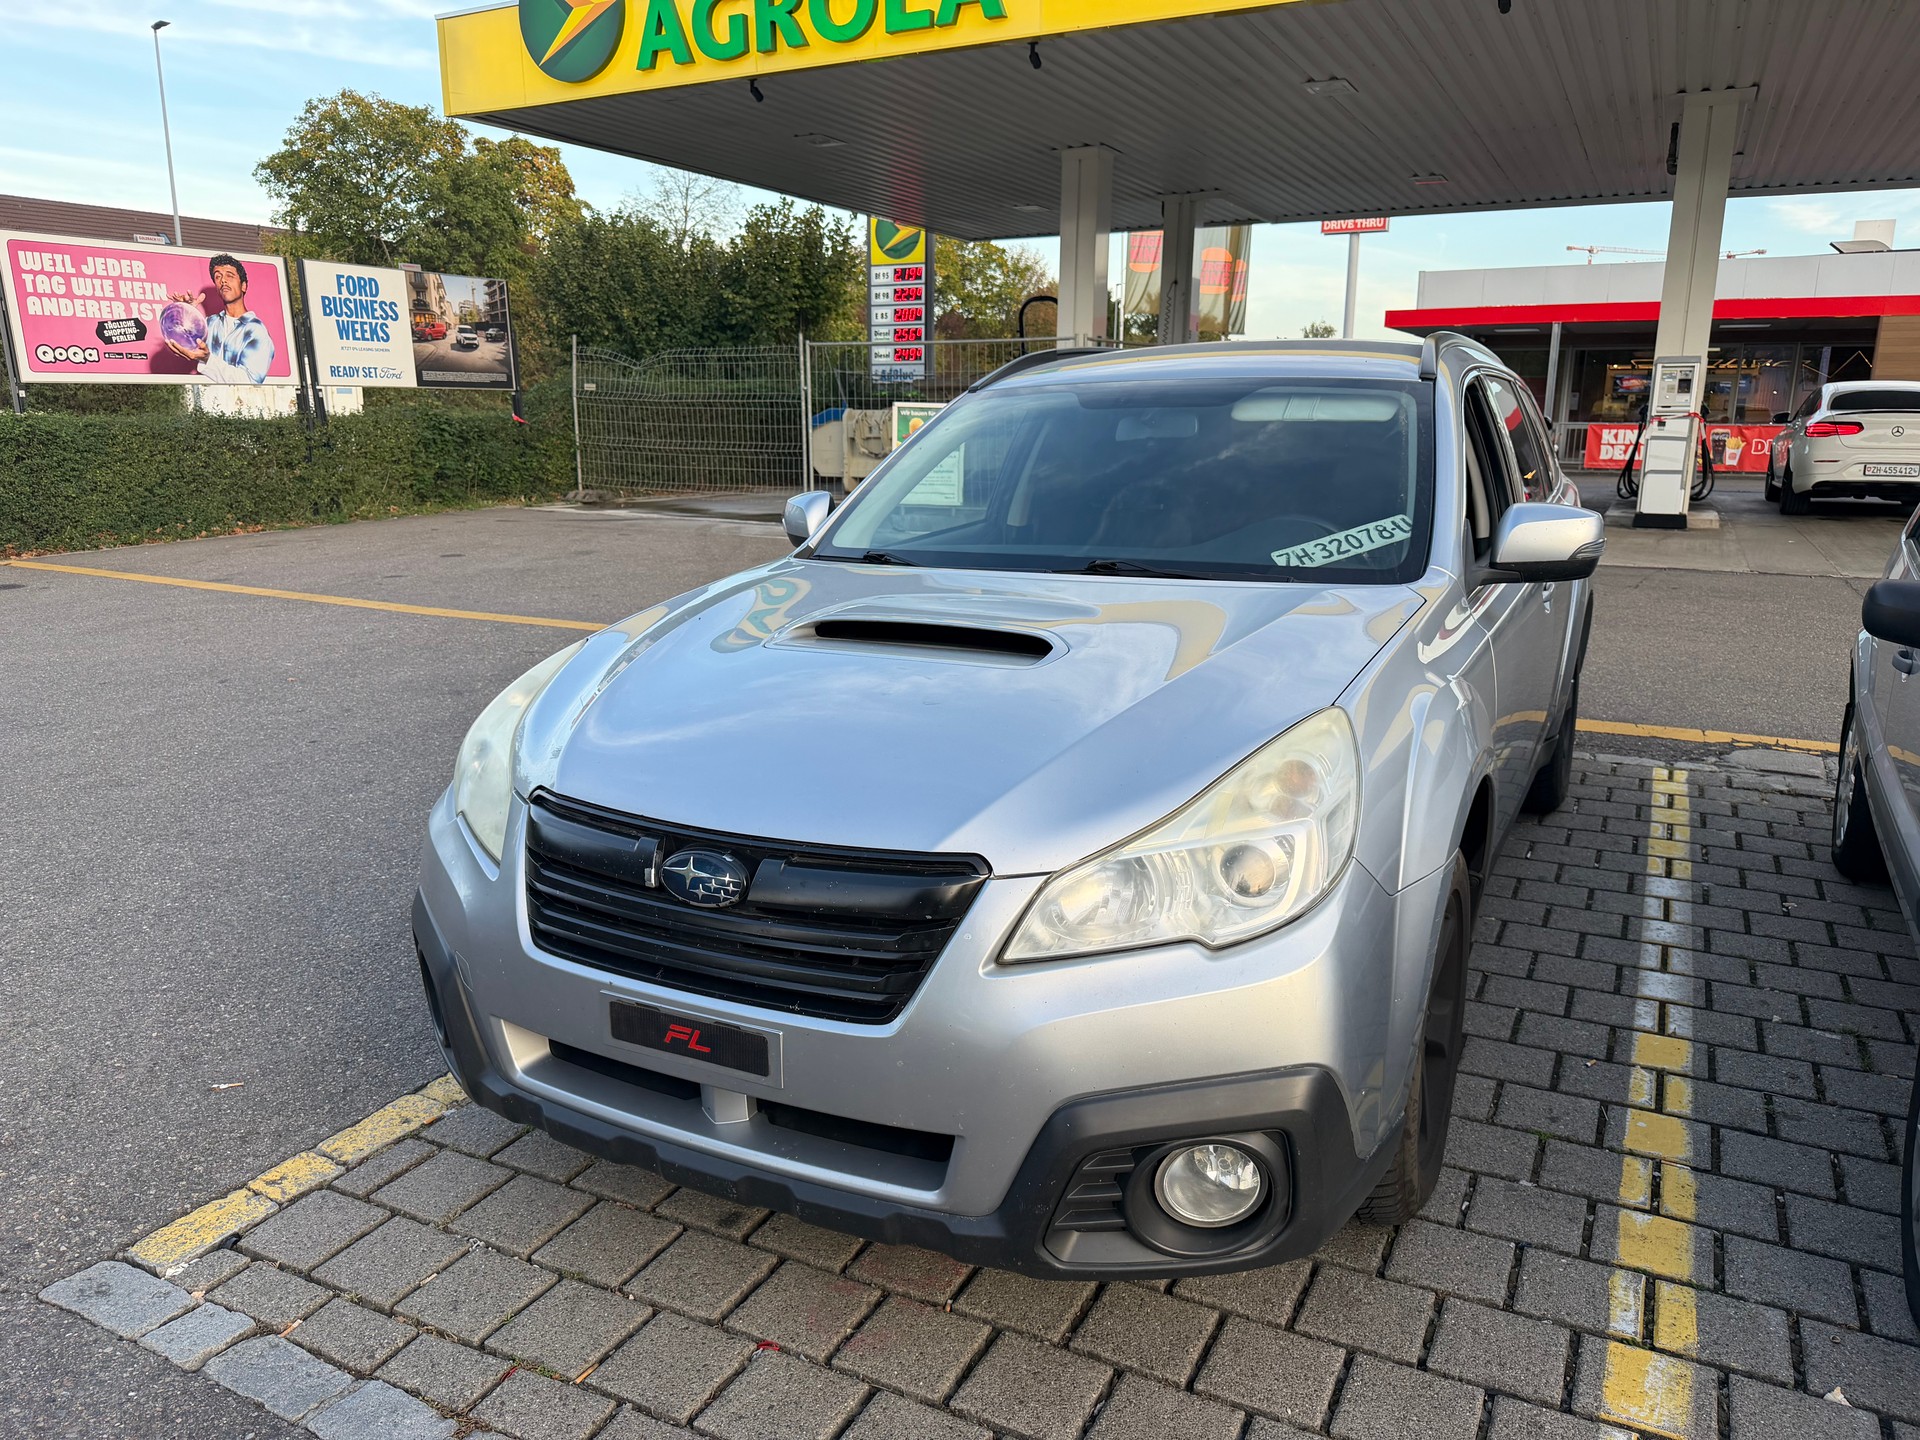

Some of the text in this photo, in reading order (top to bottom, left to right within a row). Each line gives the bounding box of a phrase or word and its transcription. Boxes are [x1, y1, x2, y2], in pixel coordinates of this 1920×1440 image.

[1323, 217, 1384, 230] DRIVE THRU
[1130, 236, 1162, 246] BURGE
[18, 250, 147, 279] WEIL JEDER
[1201, 261, 1232, 272] URGER
[882, 272, 889, 280] 95
[22, 273, 168, 301] TAG WIE KEIN
[336, 274, 380, 298] FORD
[882, 292, 889, 300] 98
[26, 296, 163, 321] ANDERER IST
[321, 295, 399, 321] BUSINESS
[880, 312, 888, 320] 85
[103, 320, 136, 330] TÄGLICHE
[335, 319, 390, 343] WEEKS
[103, 327, 140, 337] SHOPPING-
[112, 334, 137, 343] PERLEN
[874, 329, 890, 337] Diesel
[35, 344, 100, 364] QoQa
[874, 351, 891, 359] Diesel
[330, 365, 403, 380] READY SET Ford
[1601, 428, 1645, 444] KIN
[663, 1023, 711, 1053] FL
